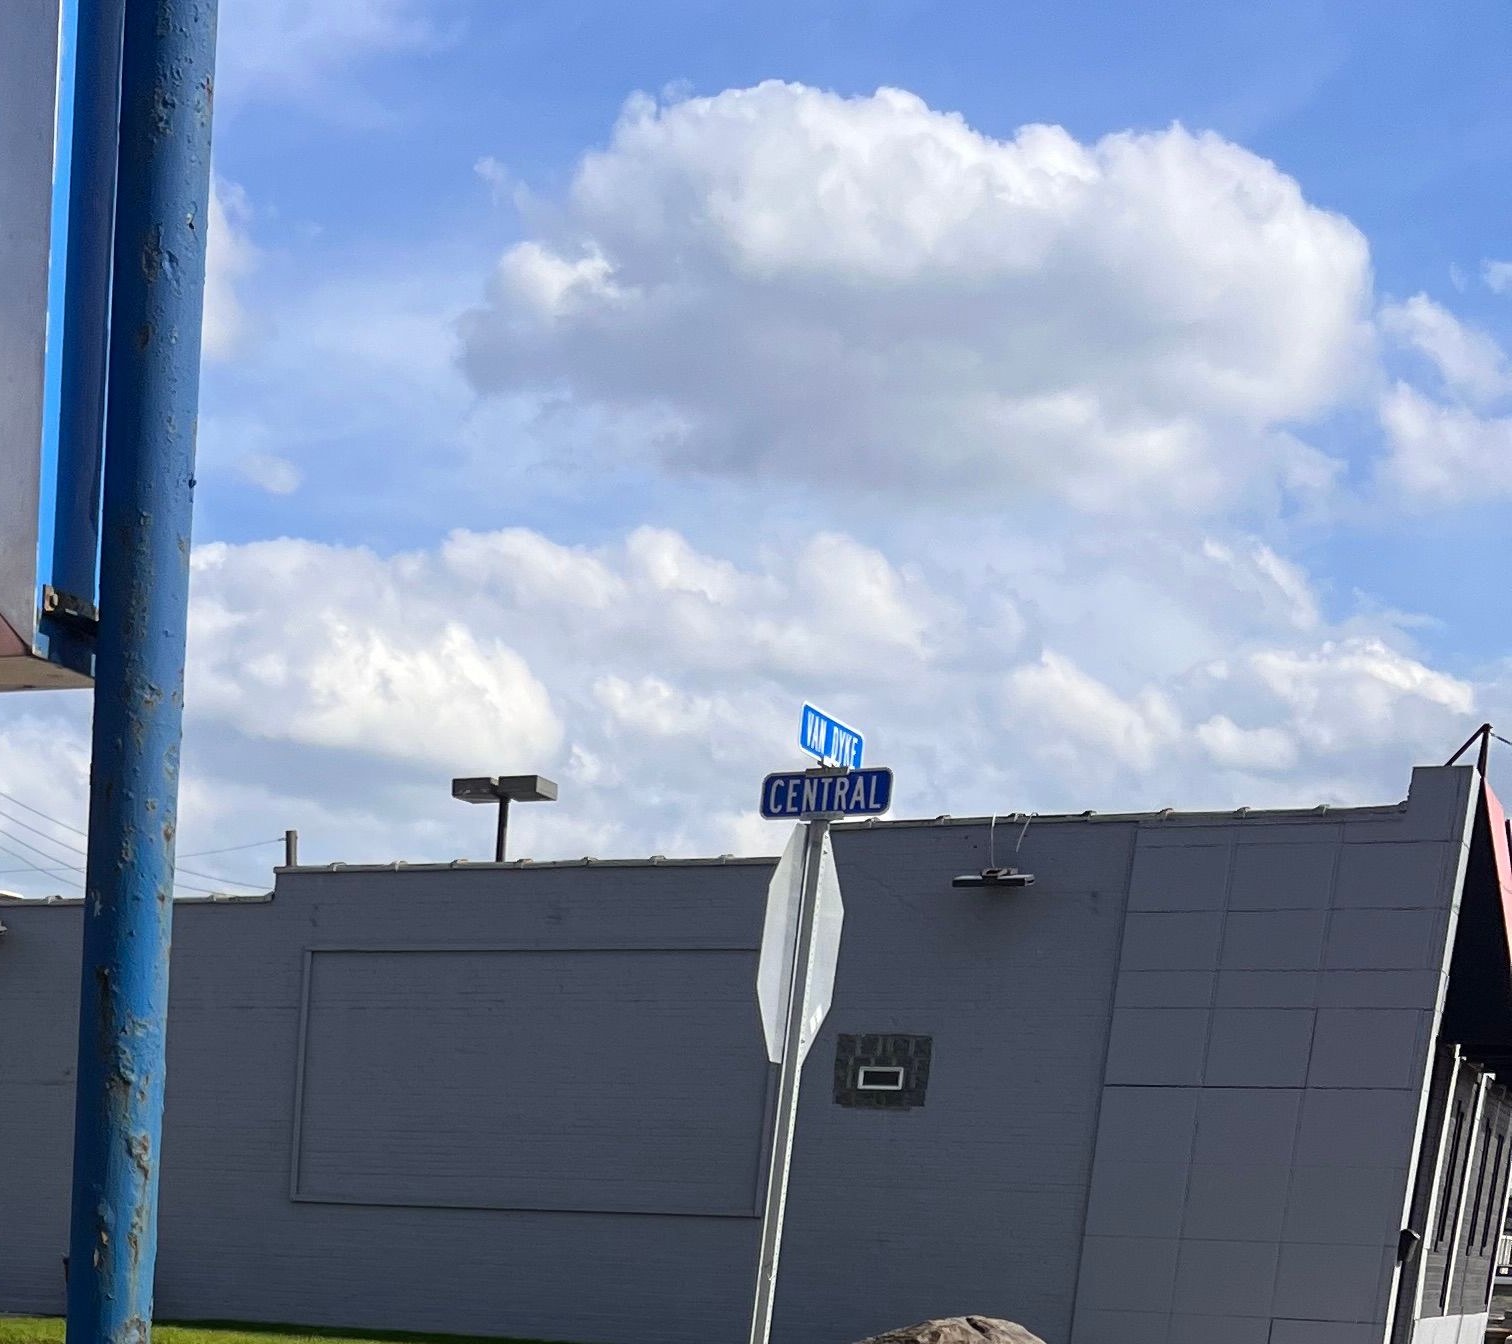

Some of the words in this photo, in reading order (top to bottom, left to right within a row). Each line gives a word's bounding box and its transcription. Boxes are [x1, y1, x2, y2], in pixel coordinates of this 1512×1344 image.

[807, 711, 827, 754] VAN
[831, 726, 858, 769] DYKE
[769, 775, 881, 814] CENTRAL
